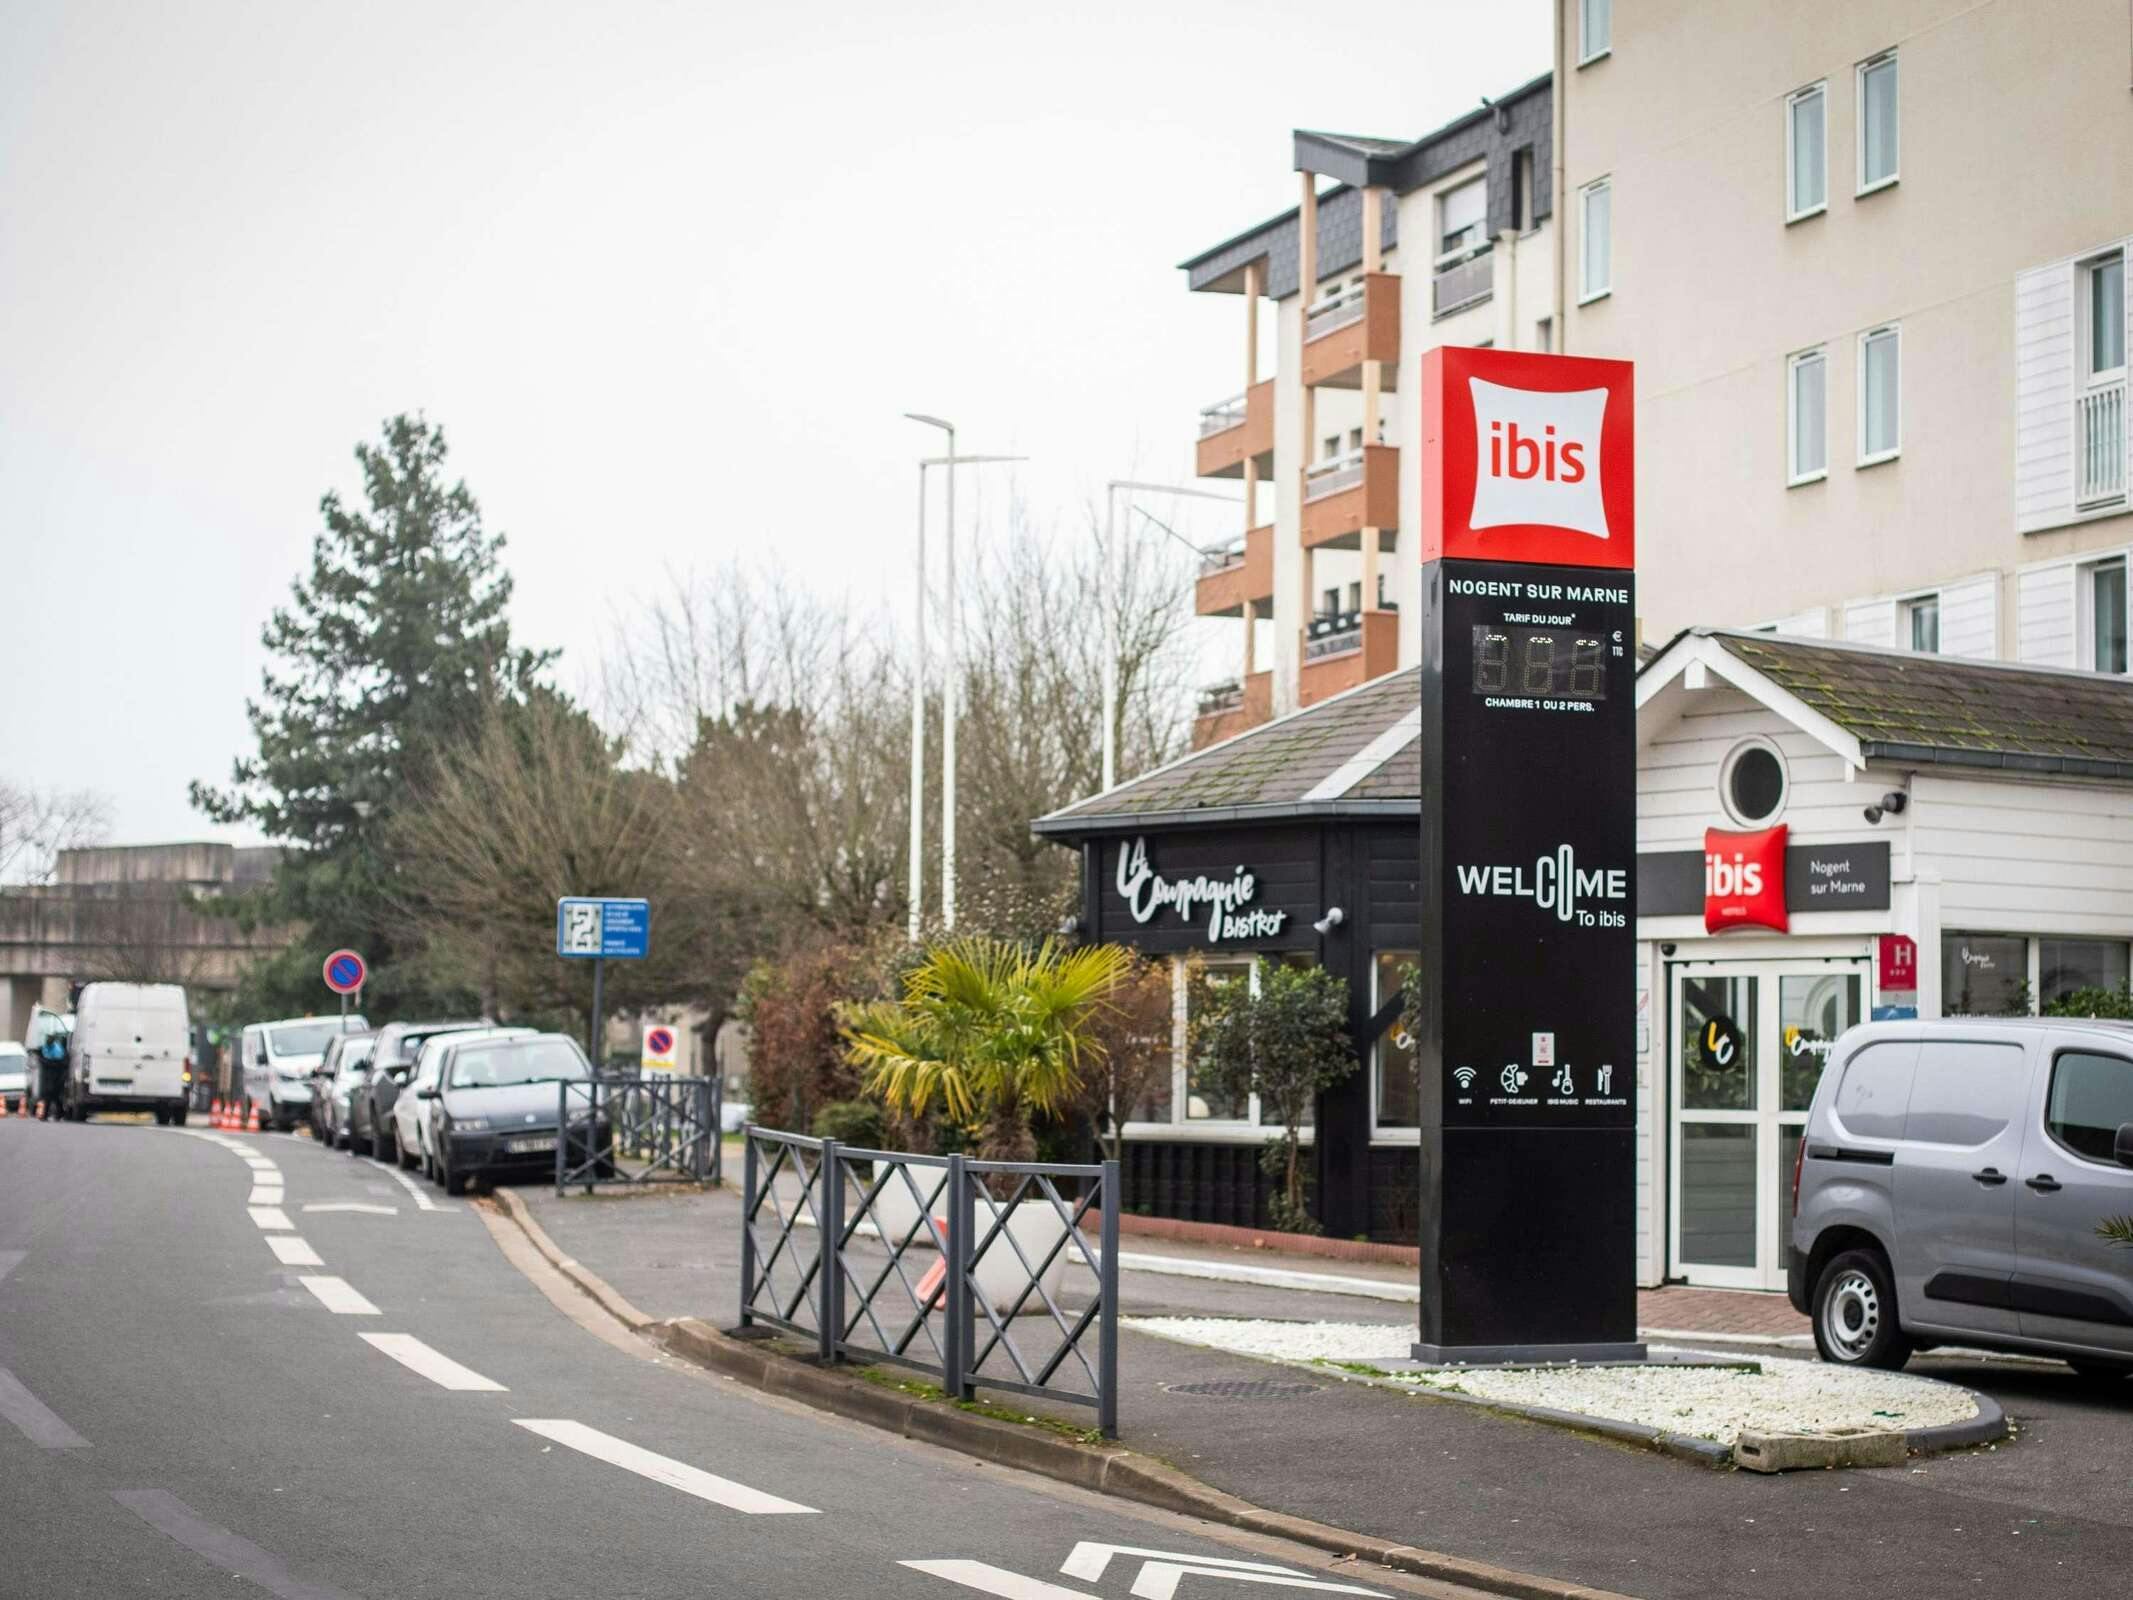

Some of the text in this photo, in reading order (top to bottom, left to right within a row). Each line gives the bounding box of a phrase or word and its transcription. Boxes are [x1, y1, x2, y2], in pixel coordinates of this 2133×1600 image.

[1490, 421, 1586, 484] ibis
[1449, 579, 1629, 604] NOGENT SUR MARNE
[1503, 613, 1531, 623] TARIF
[1532, 615, 1547, 624] DU
[1612, 630, 1622, 643] €
[1612, 646, 1623, 657] TTC
[1485, 697, 1535, 709] CHAMBRE
[1543, 700, 1557, 710] OU
[1559, 700, 1566, 710] 2
[1567, 700, 1595, 712] PERS.
[1705, 853, 1763, 897] ibis
[1810, 859, 1850, 877] Nogent
[1457, 844, 1626, 922] WELCOME
[1810, 880, 1866, 895] sur Marne
[1576, 910, 1626, 927] To ibis
[1894, 944, 1912, 966] H
